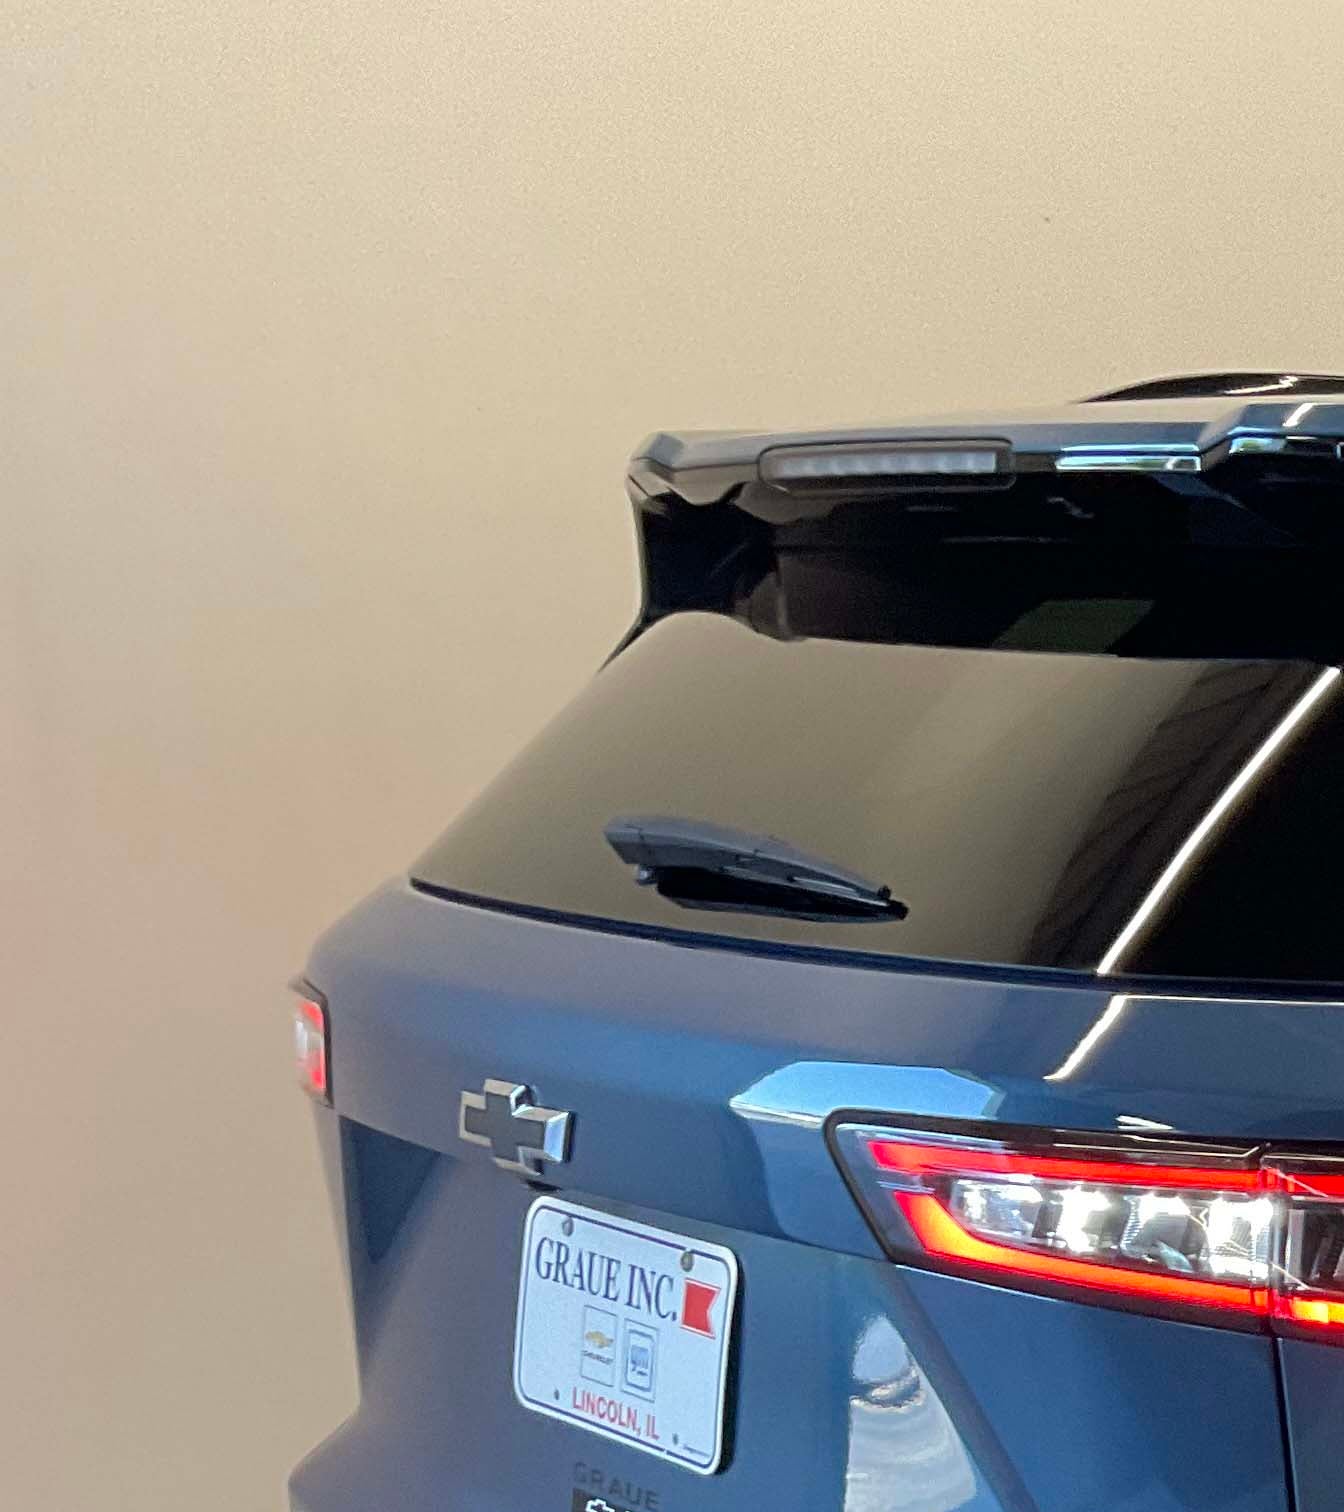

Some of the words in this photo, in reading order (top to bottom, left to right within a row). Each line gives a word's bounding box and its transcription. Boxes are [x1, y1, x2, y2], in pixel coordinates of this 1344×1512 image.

[535, 1236, 621, 1303] GRAUE
[624, 1264, 677, 1322] INC.
[572, 1386, 642, 1437] LINCOLN,
[646, 1414, 660, 1440] IL
[574, 1462, 660, 1512] GRAUE
